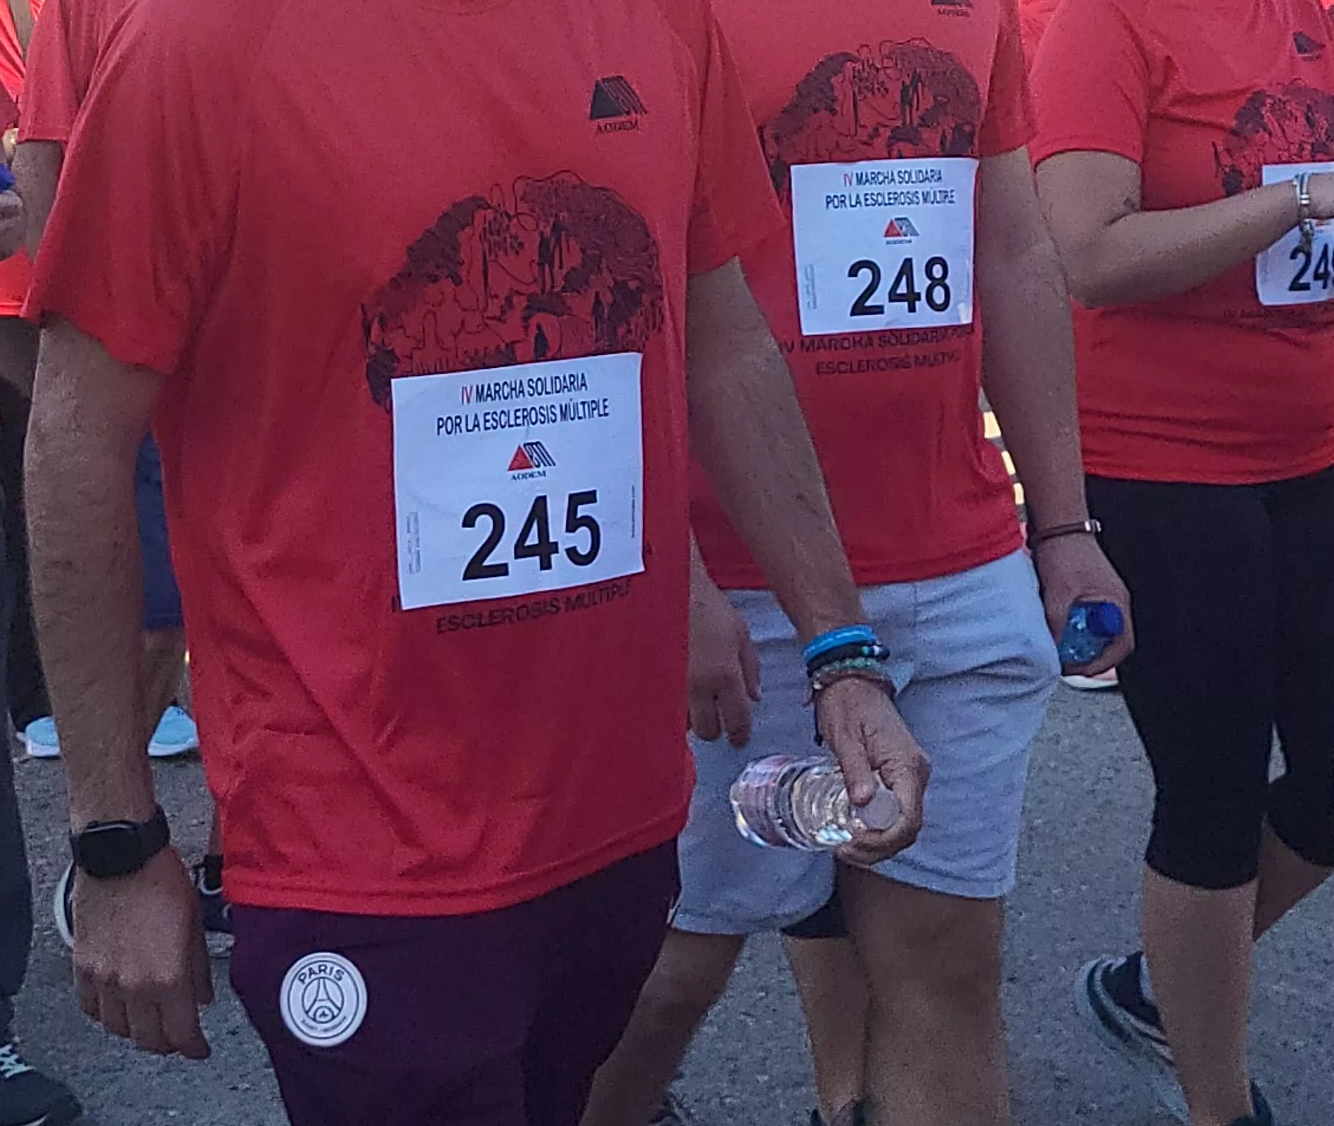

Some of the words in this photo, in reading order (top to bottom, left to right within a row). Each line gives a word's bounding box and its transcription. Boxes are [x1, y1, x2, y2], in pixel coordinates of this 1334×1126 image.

[855, 171, 896, 186] MARCHA
[897, 169, 943, 185] SOLIDARIA
[825, 194, 848, 210] POR
[848, 193, 863, 209] LA
[864, 190, 920, 207] ESCLEROSIS
[847, 256, 951, 317] 248
[461, 385, 474, 405] IV
[475, 378, 526, 403] MARCHA
[527, 372, 588, 397] SOLIDARIA
[436, 415, 463, 436] POR
[464, 413, 481, 433] LA
[483, 406, 558, 431] ESCLEROSIS
[560, 397, 610, 423] MÚLTIPLE
[510, 470, 547, 482] AODEM
[461, 489, 602, 582] 245
[435, 596, 561, 635] ESCLEROSIS
[298, 963, 345, 985] PARIS
